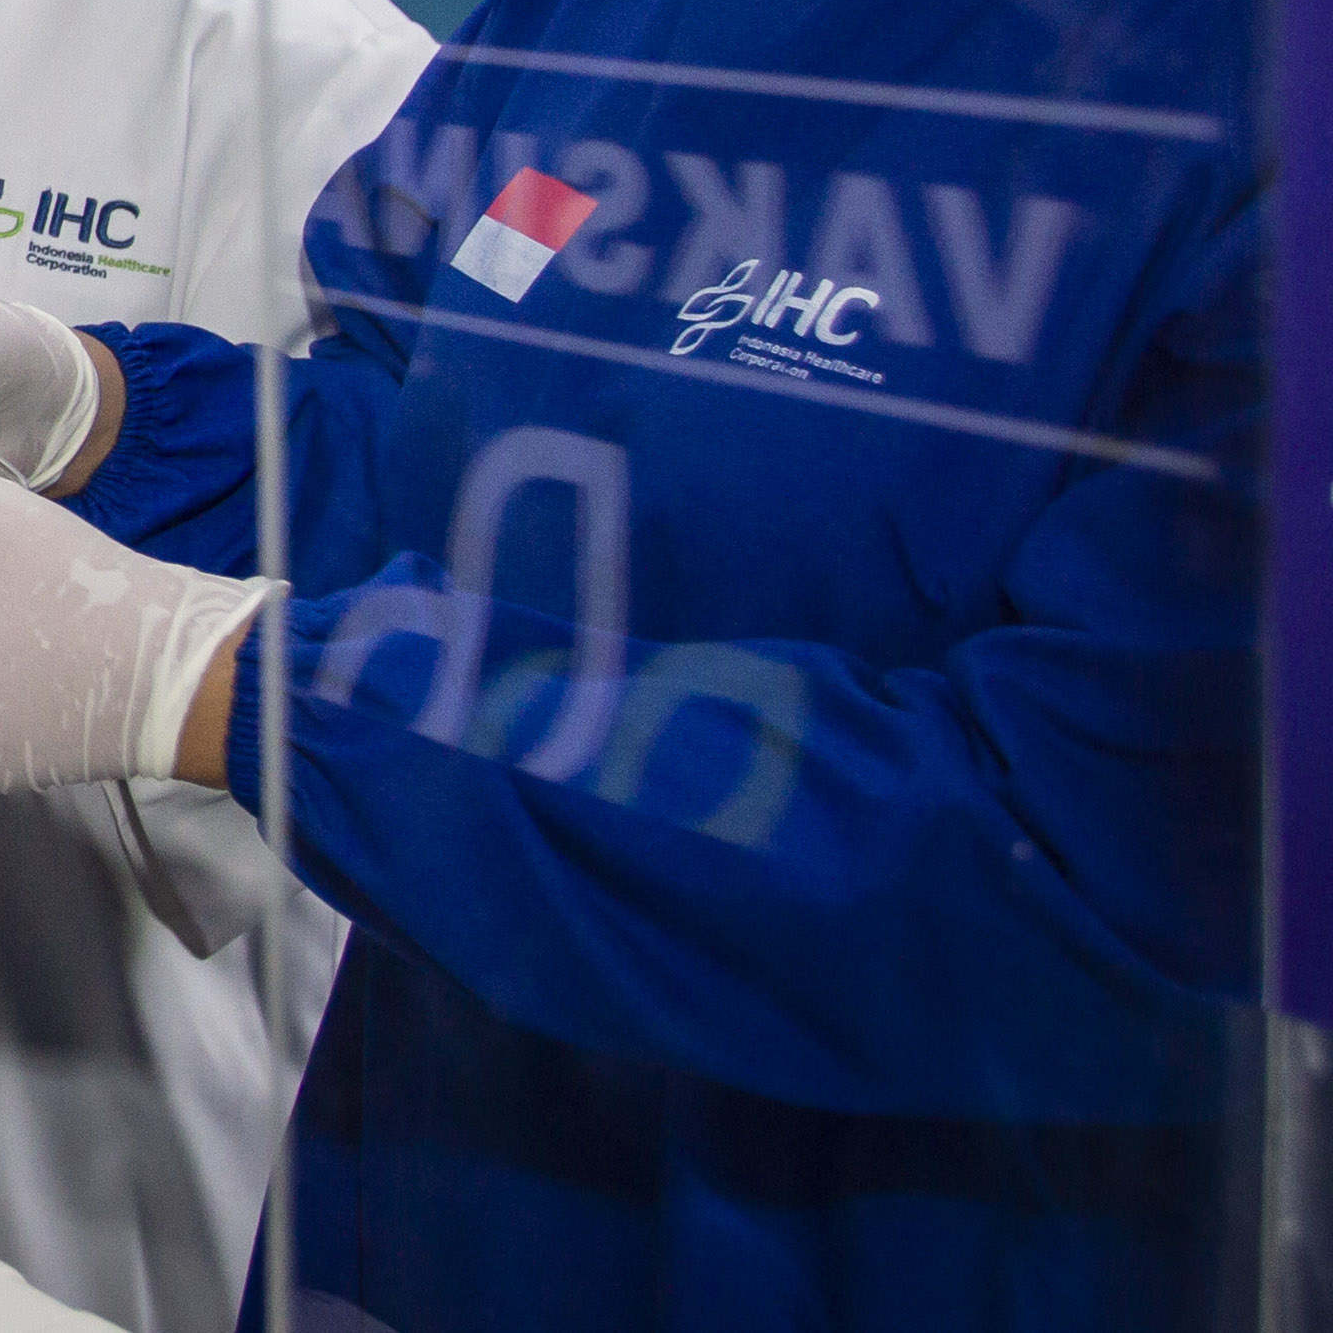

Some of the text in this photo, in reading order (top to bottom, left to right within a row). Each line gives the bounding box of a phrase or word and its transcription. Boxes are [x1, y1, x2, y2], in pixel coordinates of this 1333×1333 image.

[32, 186, 141, 250] IHC
[25, 253, 108, 279] Corporation
[28, 241, 173, 278] Indonesia Healthcare
[751, 269, 881, 346] IHC
[737, 335, 885, 385] Indonesia Healthcare
